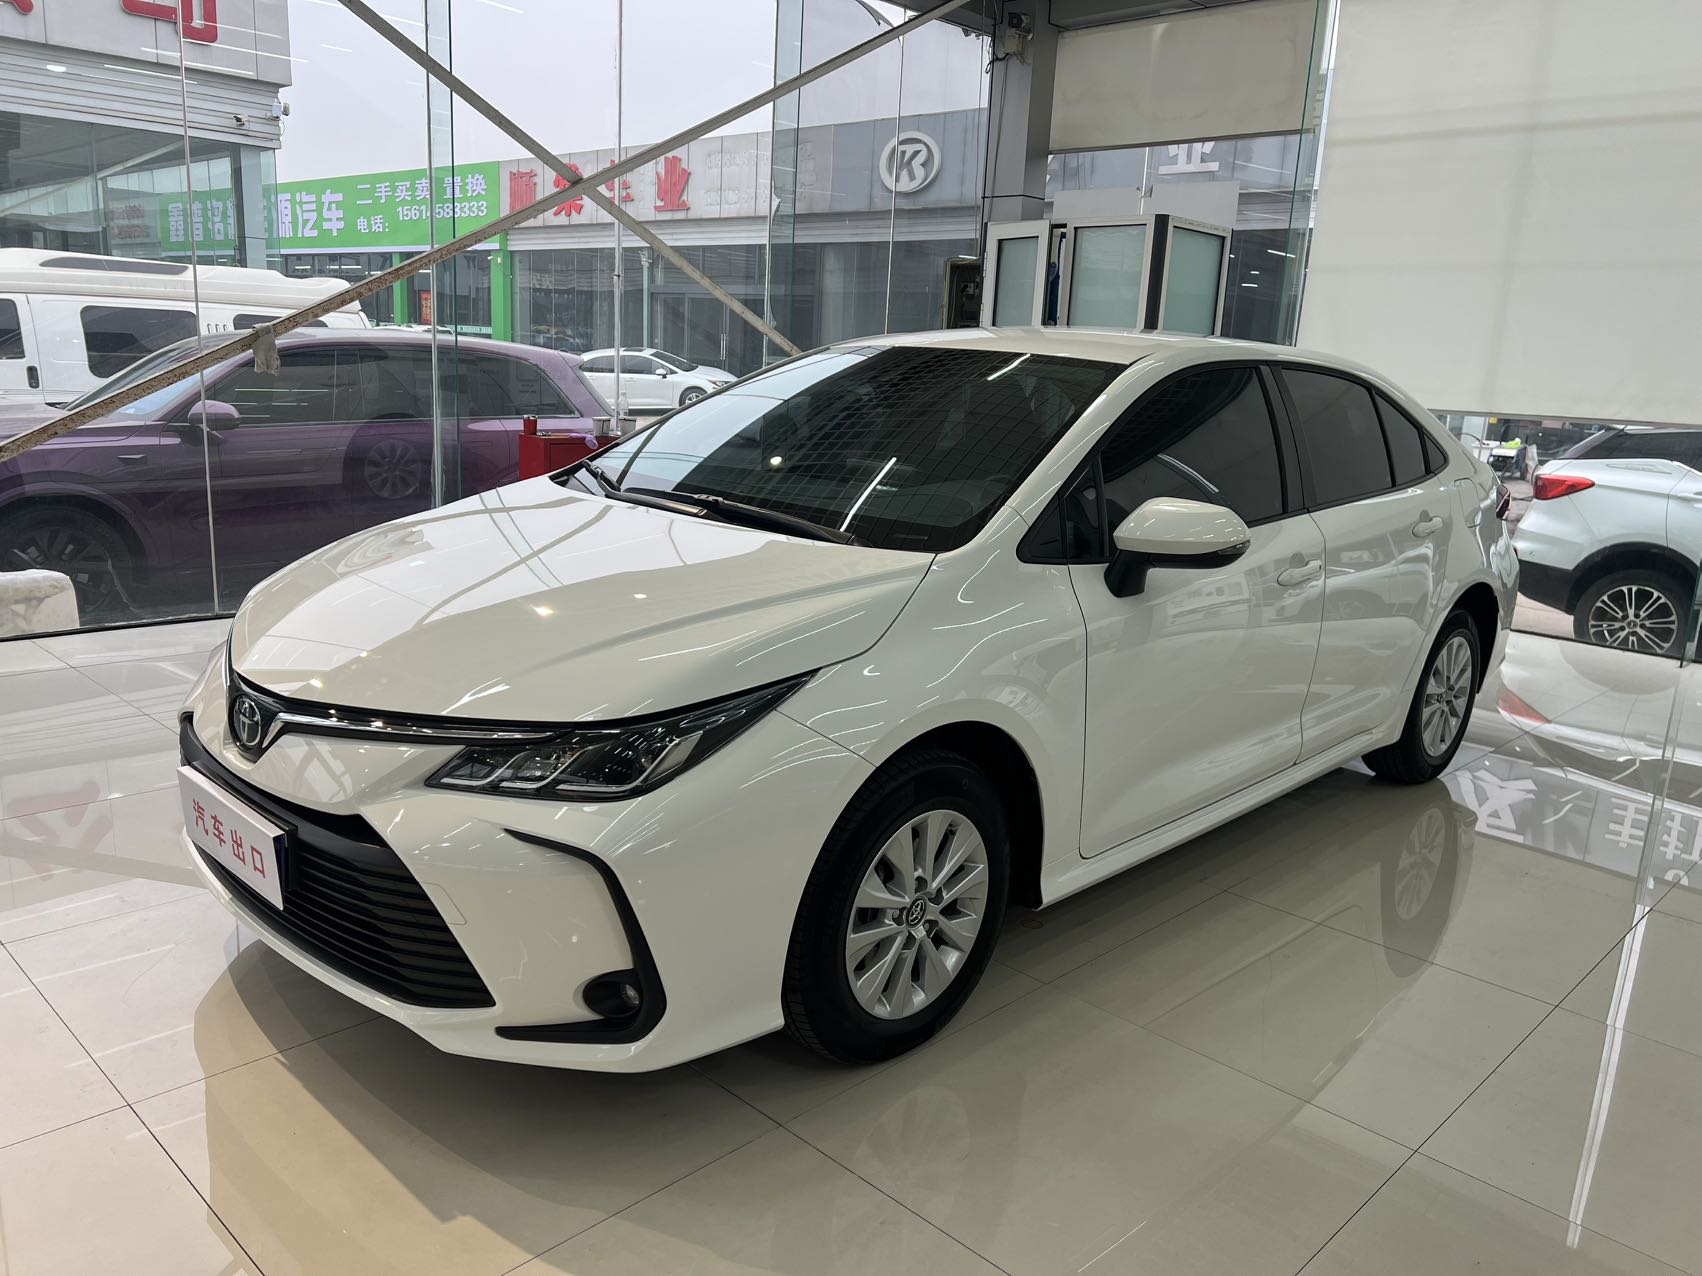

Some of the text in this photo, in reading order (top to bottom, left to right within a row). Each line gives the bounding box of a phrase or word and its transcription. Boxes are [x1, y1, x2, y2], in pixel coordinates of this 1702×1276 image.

[356, 178, 430, 205] 二手买卖
[396, 201, 487, 221] 1561588333
[192, 799, 266, 879] 汽车出口
